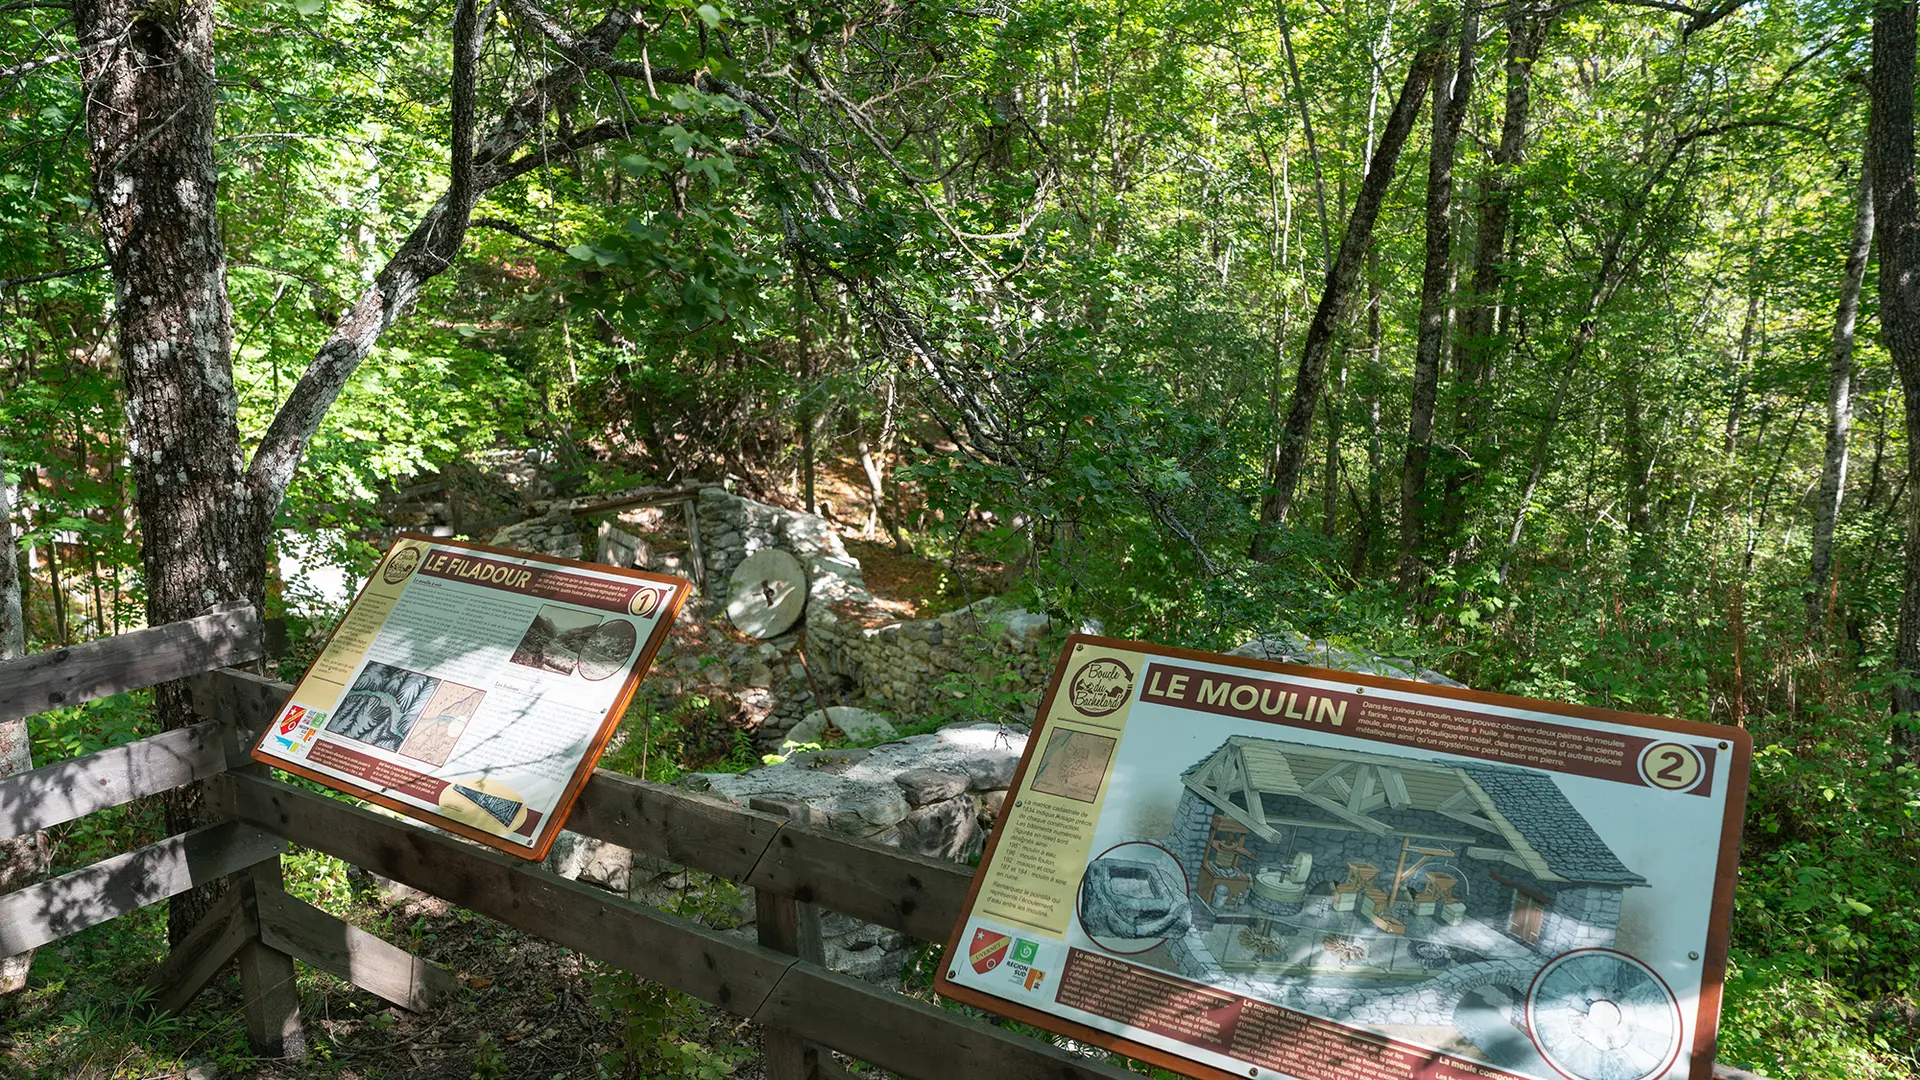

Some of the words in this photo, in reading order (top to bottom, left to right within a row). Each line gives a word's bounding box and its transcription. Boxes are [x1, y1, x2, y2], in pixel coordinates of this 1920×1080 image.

[424, 554, 448, 572] LE
[447, 558, 532, 588] FILADOUR
[638, 594, 648, 609] 1
[1089, 665, 1121, 681] Boucle
[1093, 680, 1106, 693] du
[1148, 671, 1190, 700] LE
[1196, 678, 1348, 726] MOULIN
[1362, 701, 1381, 710] Dans
[1393, 707, 1416, 715] ruines
[1426, 712, 1452, 722] moulin,
[1472, 720, 1501, 728] pouvez
[1501, 723, 1536, 734] observer
[1536, 728, 1557, 737] deux
[1557, 733, 1582, 741] paires
[1594, 739, 1625, 748] meules
[1367, 710, 1389, 721] farine,
[1441, 724, 1469, 732] meules
[1480, 728, 1499, 739] huile,
[1517, 736, 1557, 746] morceaux
[1559, 741, 1582, 750] d'une
[1585, 746, 1624, 757] ancienne
[1356, 727, 1396, 738] métalliques
[1438, 741, 1480, 752] mystérieux
[1500, 750, 1526, 759] bassin
[1539, 757, 1566, 766] pierre.
[1358, 719, 1382, 728] meule,
[1415, 727, 1458, 739] hydraulique
[1469, 737, 1493, 747] métal,
[1494, 740, 1509, 748] des
[1510, 744, 1557, 755] engrenages
[1567, 753, 1593, 761] autres
[1594, 756, 1622, 766] pièces
[1656, 751, 1686, 783] 2
[976, 942, 1002, 960] UVERNET
[1084, 955, 1106, 965] moulin
[1112, 962, 1128, 972] huile
[1014, 970, 1027, 978] SUD
[1254, 1004, 1279, 1015] moulin
[1286, 1012, 1308, 1023] farine
[1451, 1061, 1477, 1074] meule
